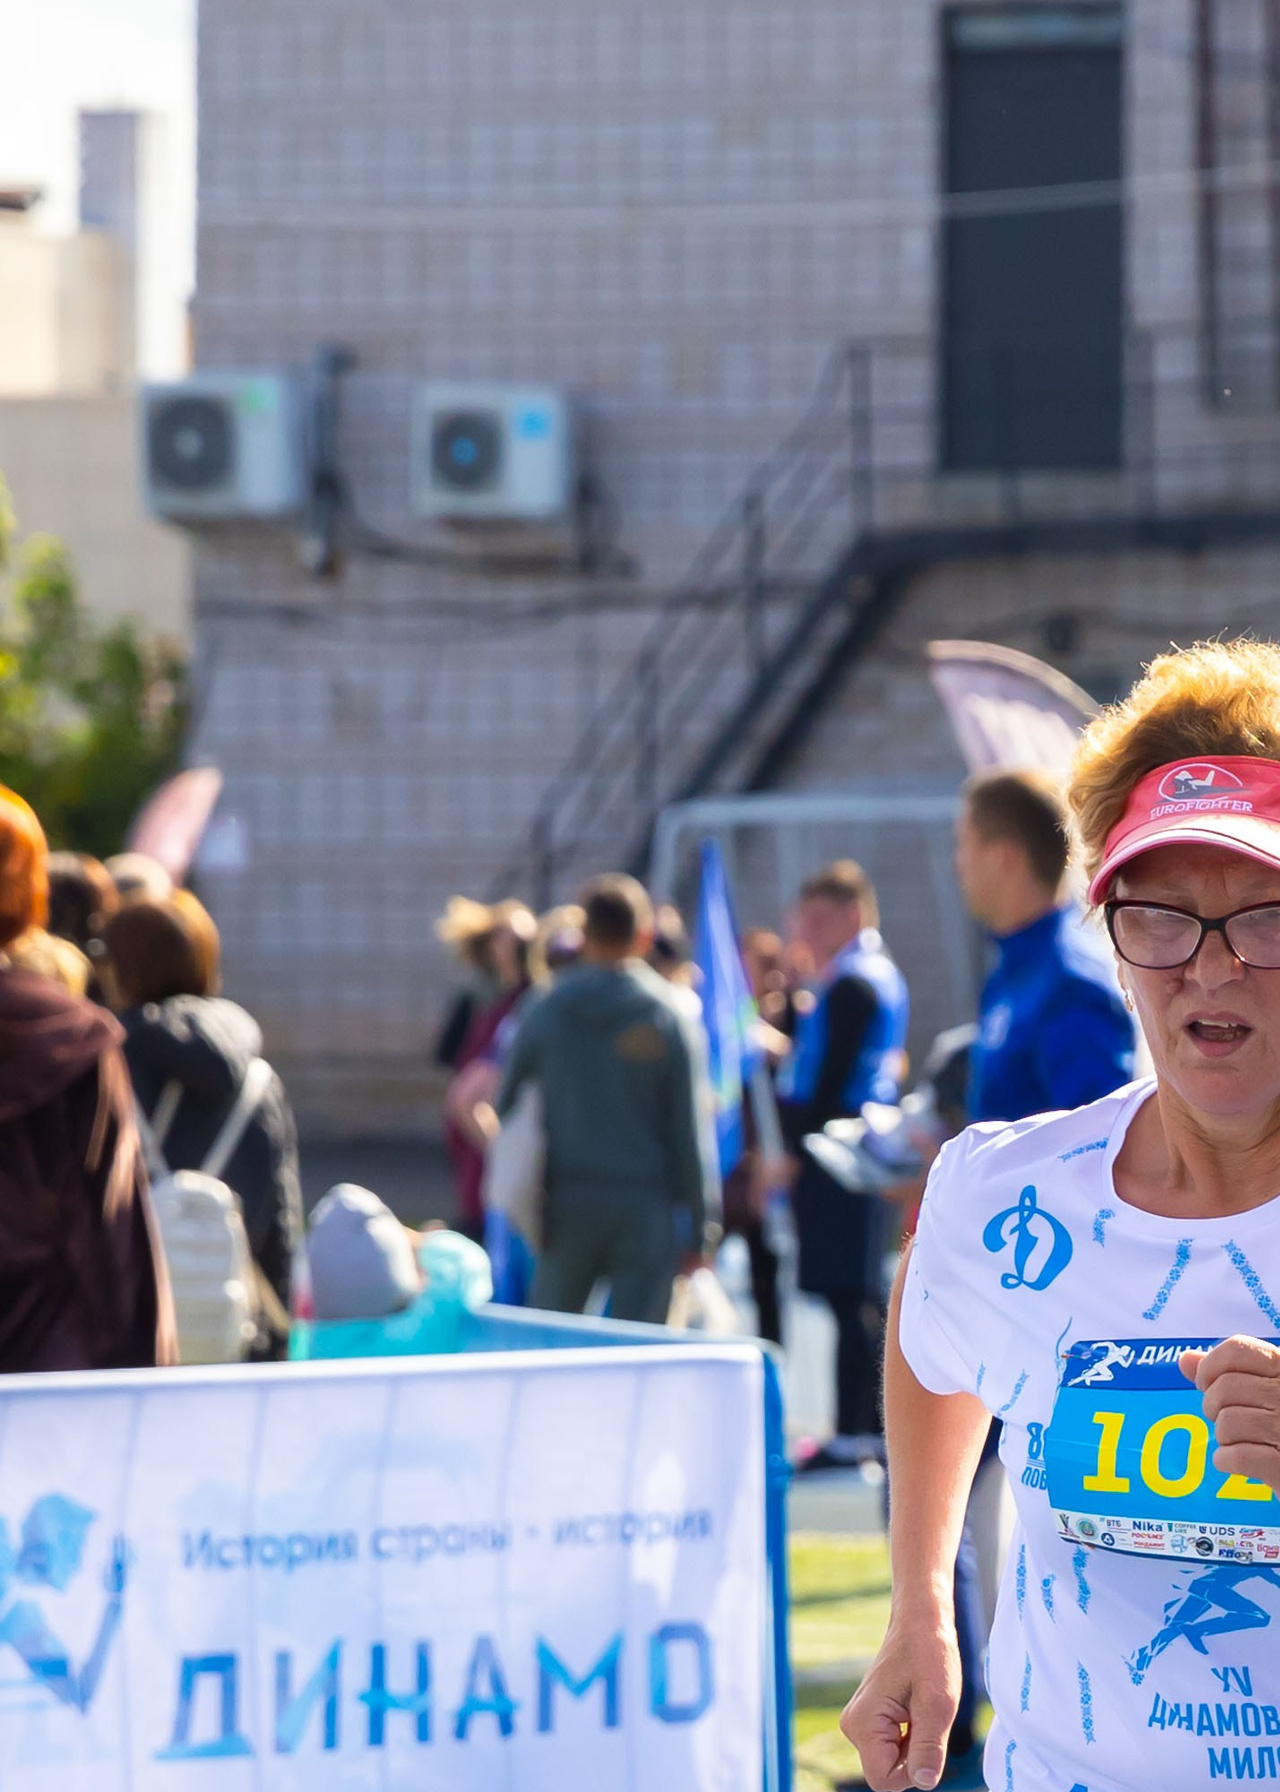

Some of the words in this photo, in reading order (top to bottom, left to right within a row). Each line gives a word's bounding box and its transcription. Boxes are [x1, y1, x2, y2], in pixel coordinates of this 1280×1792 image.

[1149, 800, 1253, 820] EUROFIGHTER
[1132, 1521, 1163, 1532] Nika
[1209, 1526, 1235, 1536] UDS
[182, 1526, 359, 1575] История
[370, 1522, 511, 1567] страны
[553, 1508, 712, 1550] история
[155, 1621, 715, 1760] ДИНАМО
